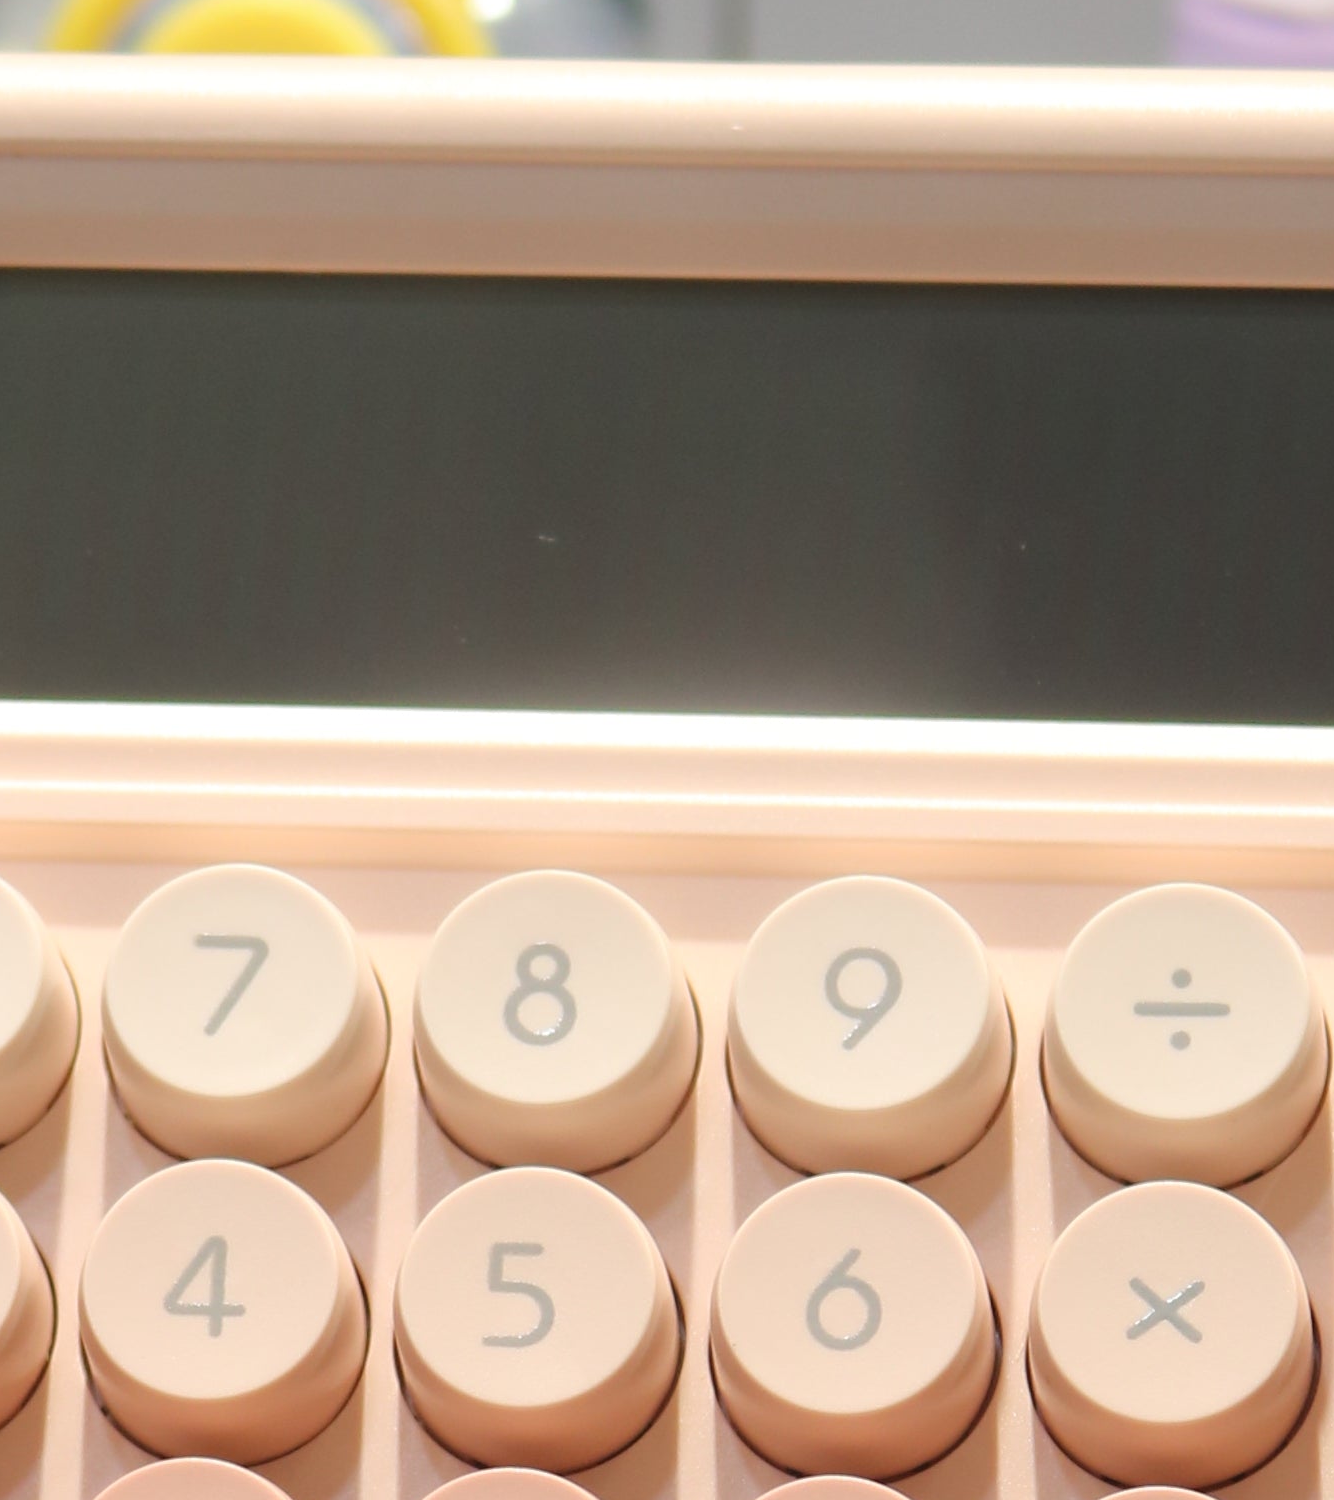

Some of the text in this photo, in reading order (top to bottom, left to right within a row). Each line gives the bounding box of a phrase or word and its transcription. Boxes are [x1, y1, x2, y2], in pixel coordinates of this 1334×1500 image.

[193, 932, 269, 1036] 7
[502, 940, 578, 1047] 8
[823, 945, 903, 1052] 9
[163, 1235, 246, 1340] 4
[481, 1241, 555, 1349] 5
[804, 1247, 883, 1353] 6
